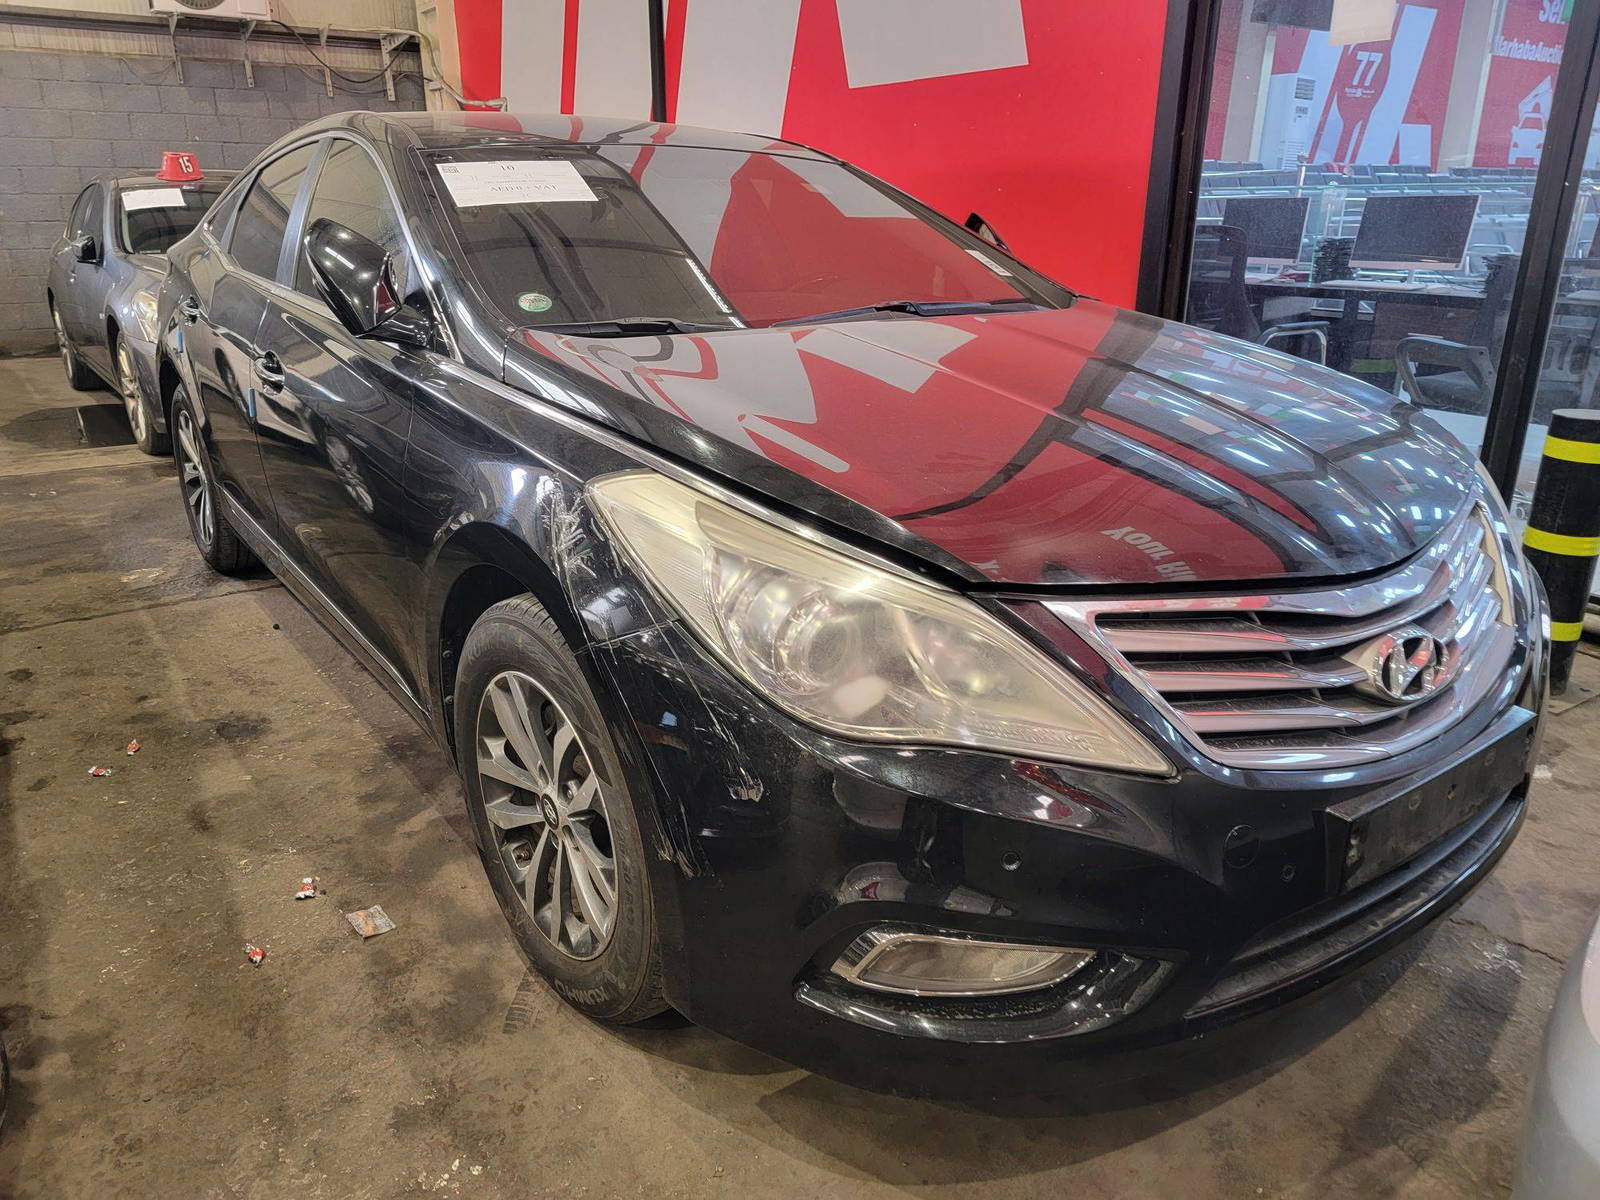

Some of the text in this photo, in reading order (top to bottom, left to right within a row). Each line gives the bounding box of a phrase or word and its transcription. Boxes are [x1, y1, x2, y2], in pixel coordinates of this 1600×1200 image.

[1351, 51, 1383, 86] 77
[179, 156, 194, 173] 15
[554, 978, 609, 1005] KUMHO
